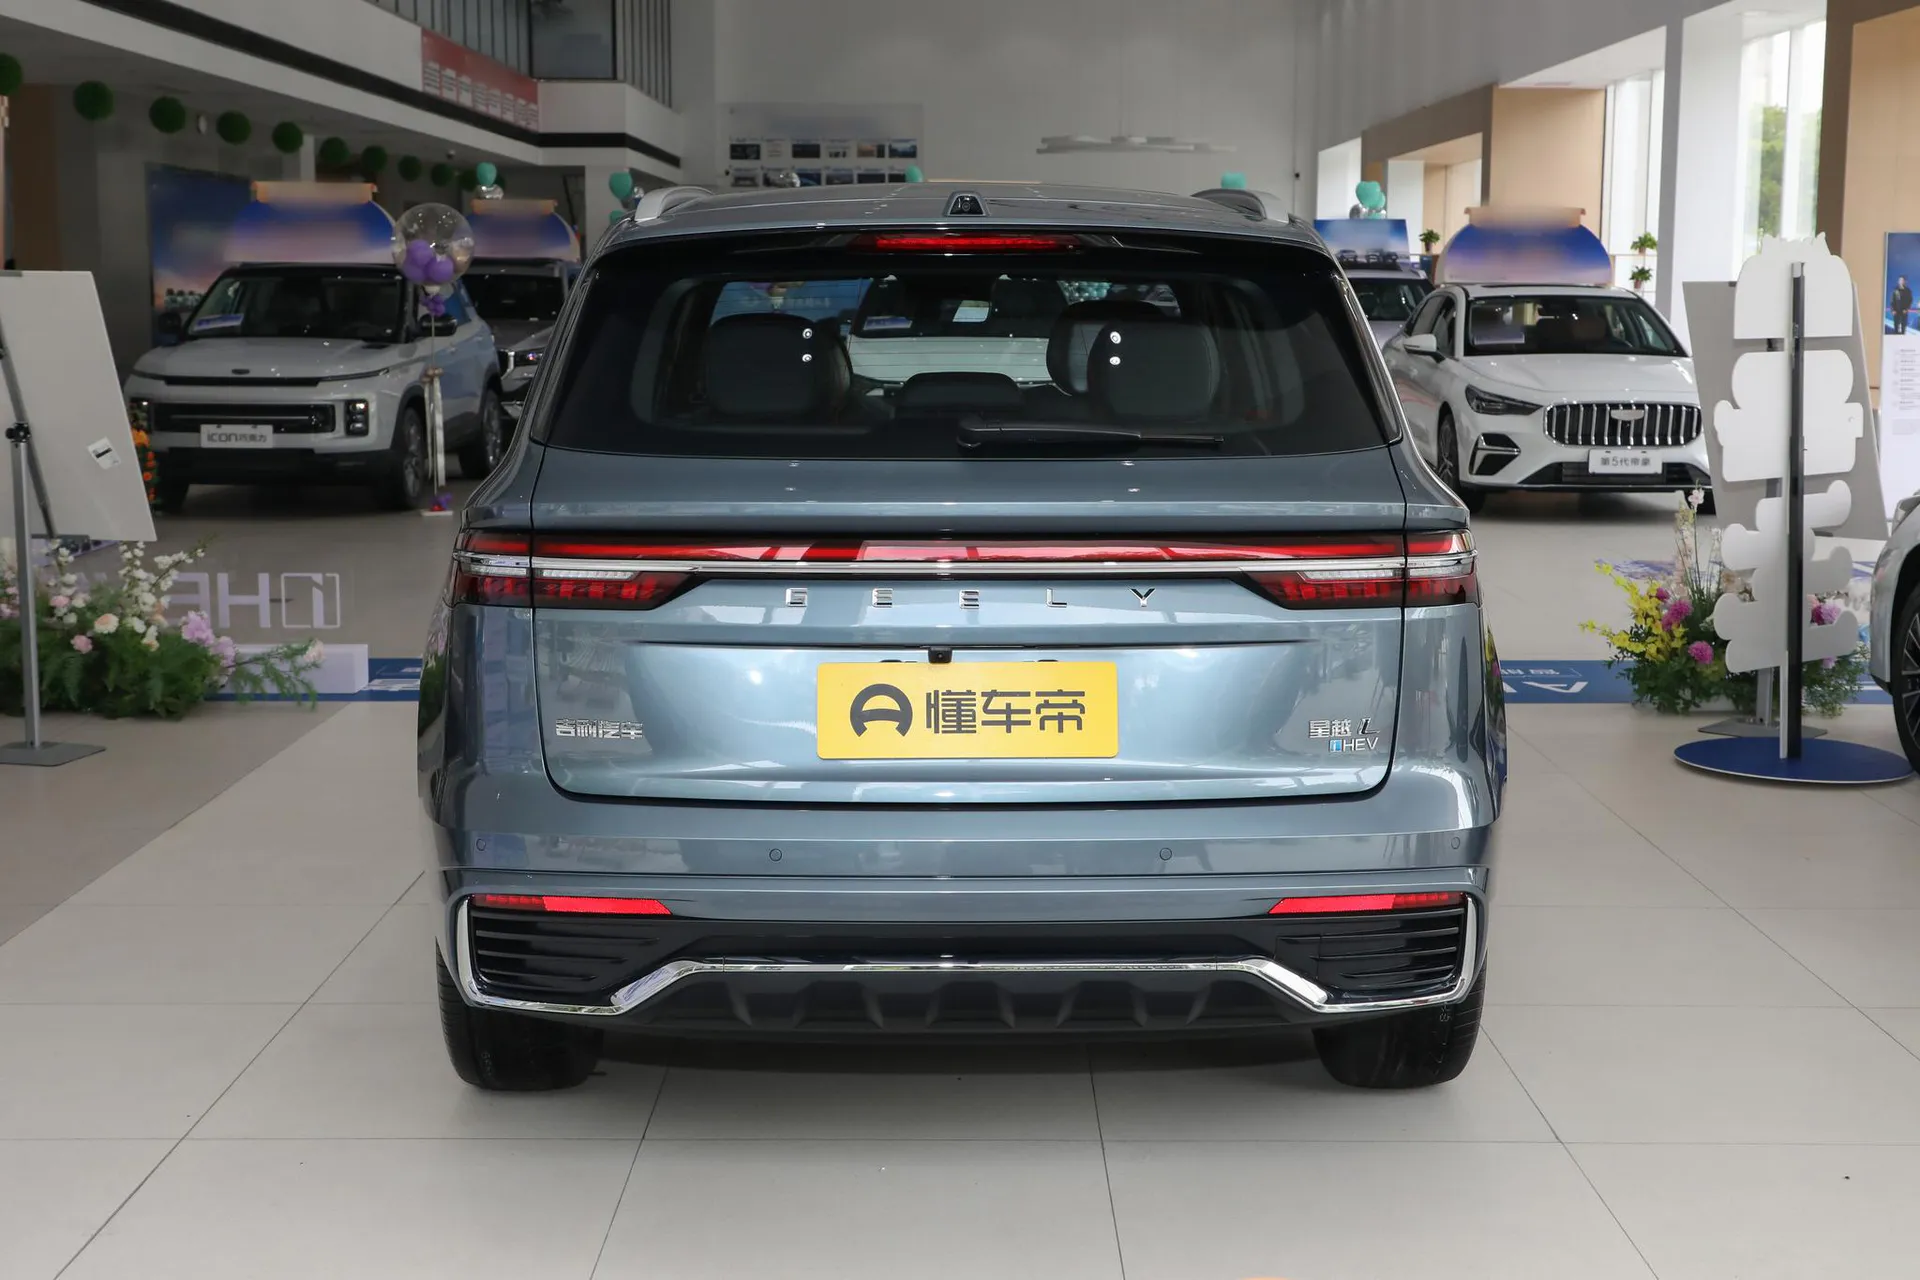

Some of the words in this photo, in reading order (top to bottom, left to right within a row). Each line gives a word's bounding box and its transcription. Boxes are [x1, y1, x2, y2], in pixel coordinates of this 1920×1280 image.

[785, 587, 1156, 610] GEELY
[926, 689, 1086, 734] 懂车帝
[555, 719, 643, 740] 吉利汽车
[1308, 719, 1352, 739] 星越
